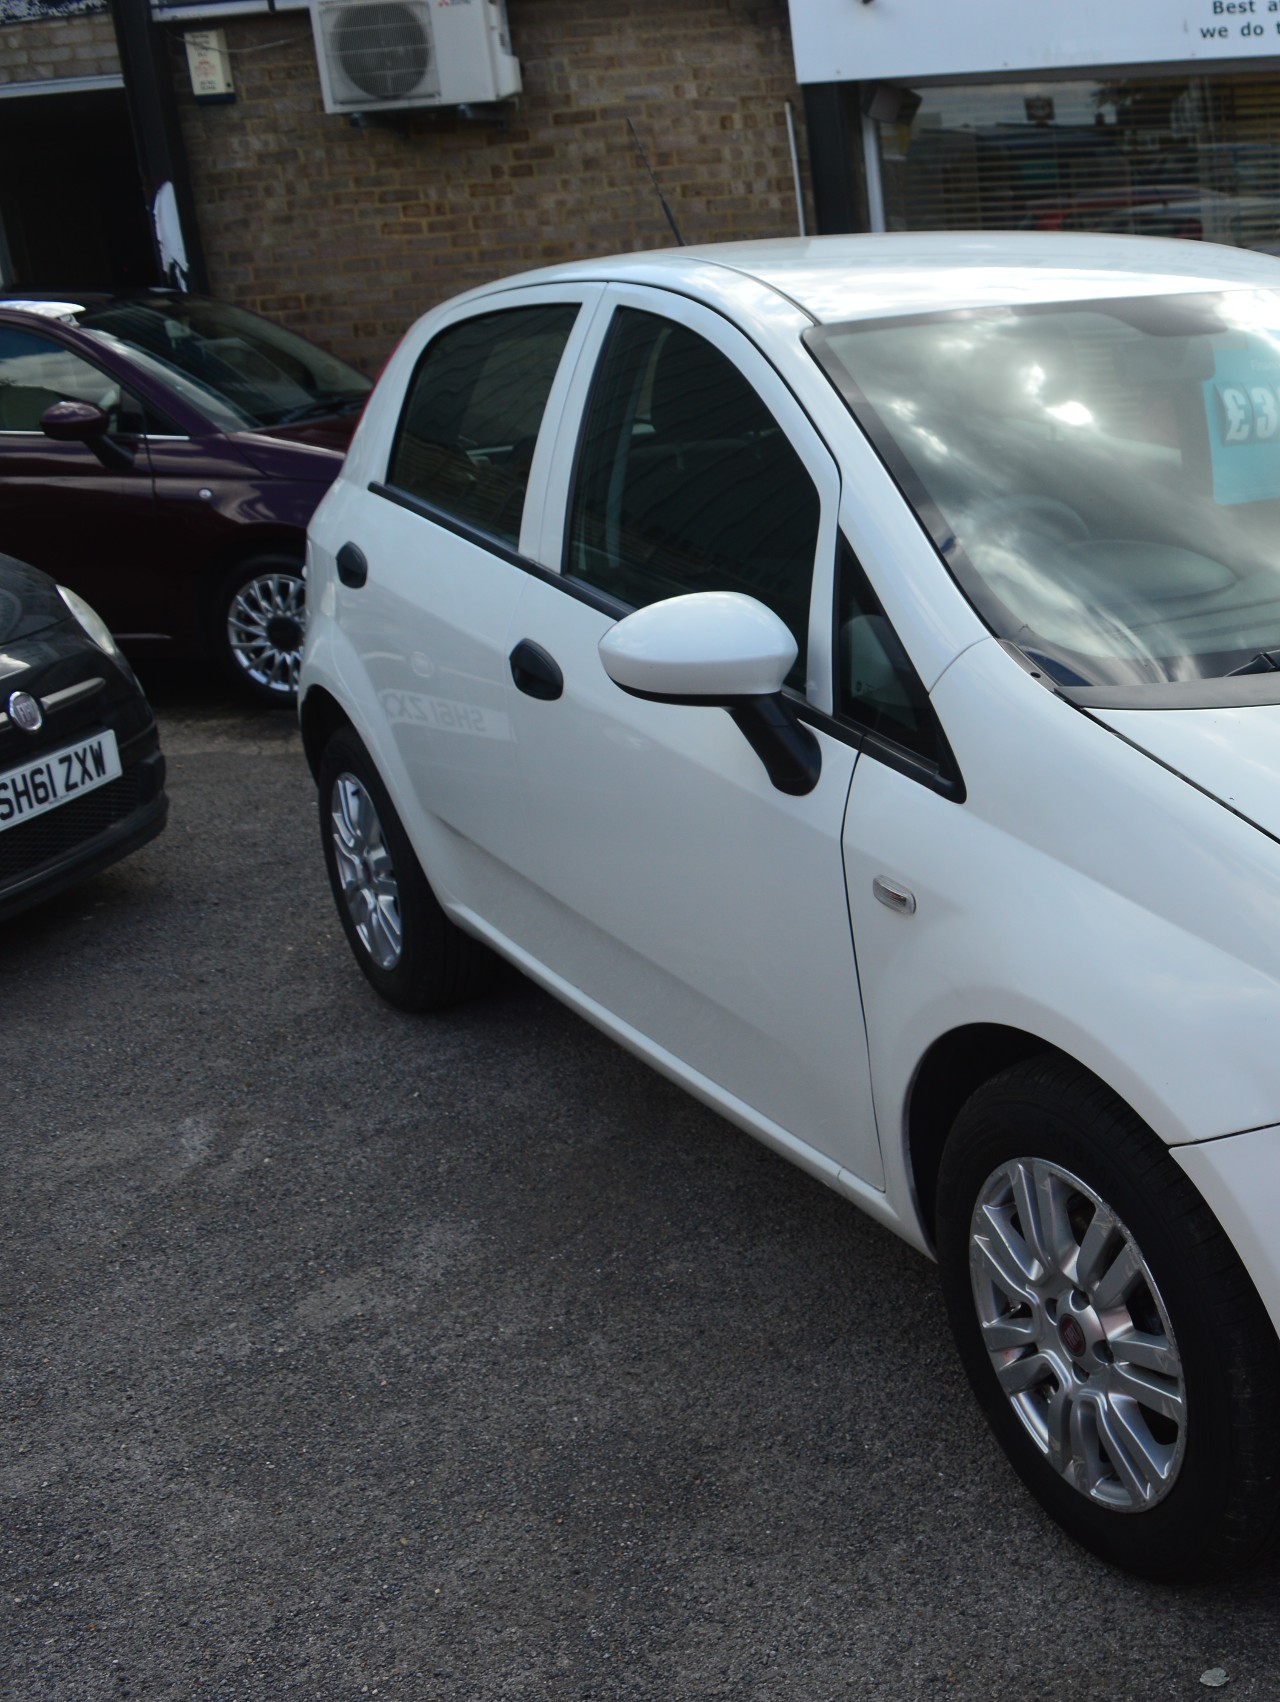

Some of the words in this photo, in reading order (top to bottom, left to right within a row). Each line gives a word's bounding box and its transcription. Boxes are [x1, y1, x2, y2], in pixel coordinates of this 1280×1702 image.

[1212, 0, 1256, 15] Best
[1200, 25, 1229, 39] we
[1241, 21, 1264, 37] do
[0, 763, 59, 821] SH61
[58, 740, 107, 793] ZXW
